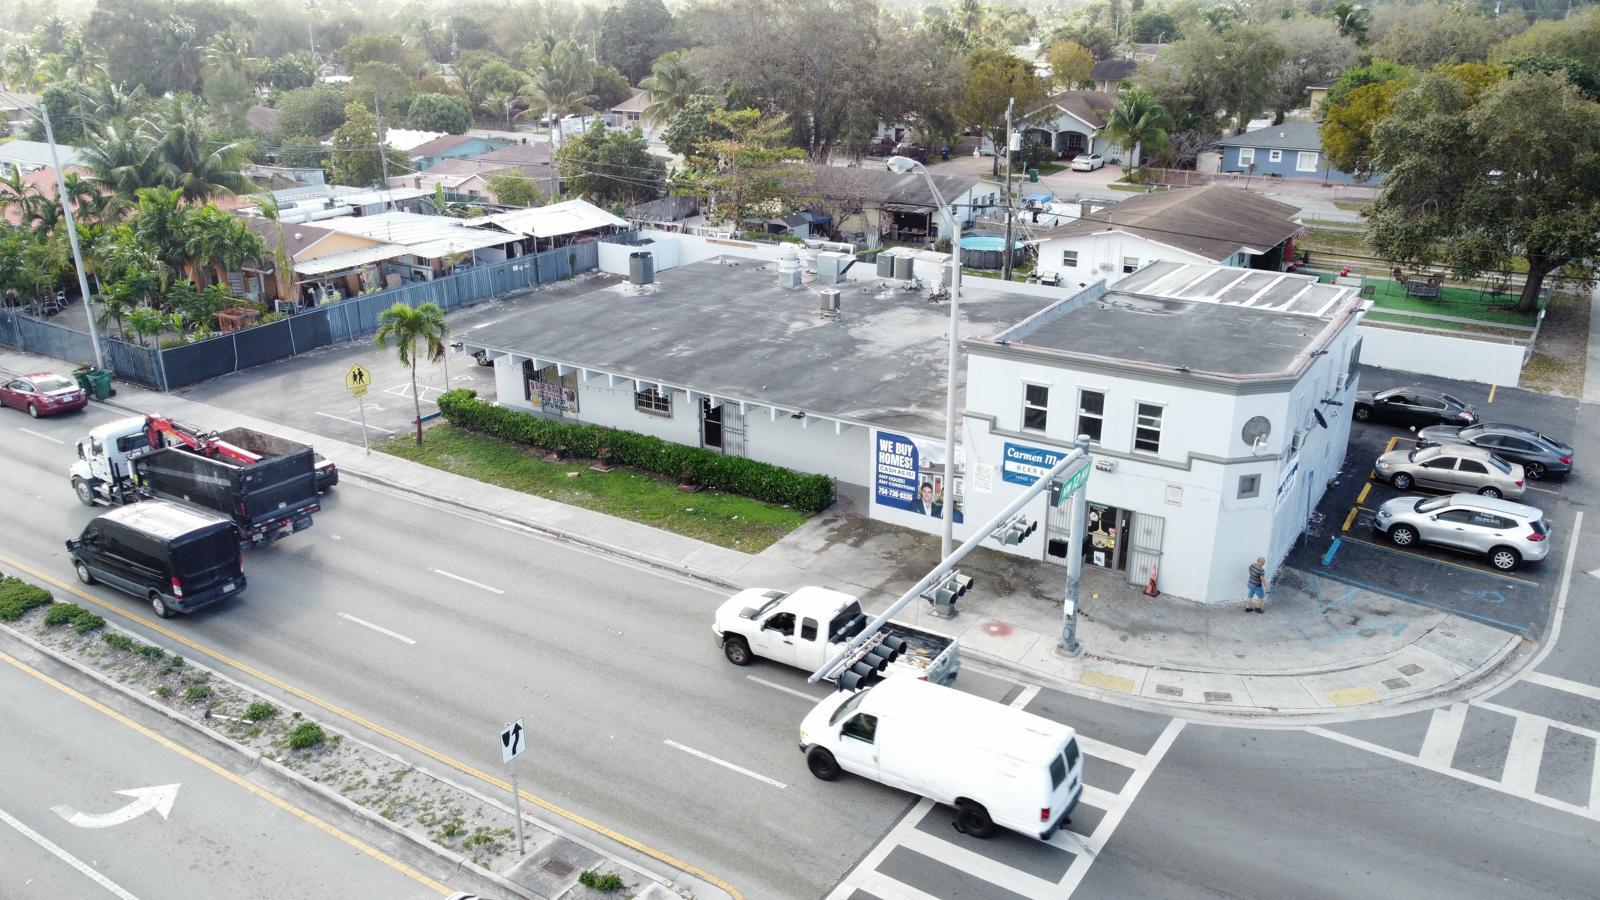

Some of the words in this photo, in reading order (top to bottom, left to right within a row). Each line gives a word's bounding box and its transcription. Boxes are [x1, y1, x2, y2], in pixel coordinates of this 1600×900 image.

[880, 439, 893, 453] WE
[896, 442, 913, 457] BUY
[1007, 447, 1043, 463] Carmen
[879, 452, 913, 469] HOMES!
[880, 466, 896, 474] CASH
[1016, 465, 1038, 475] BEER
